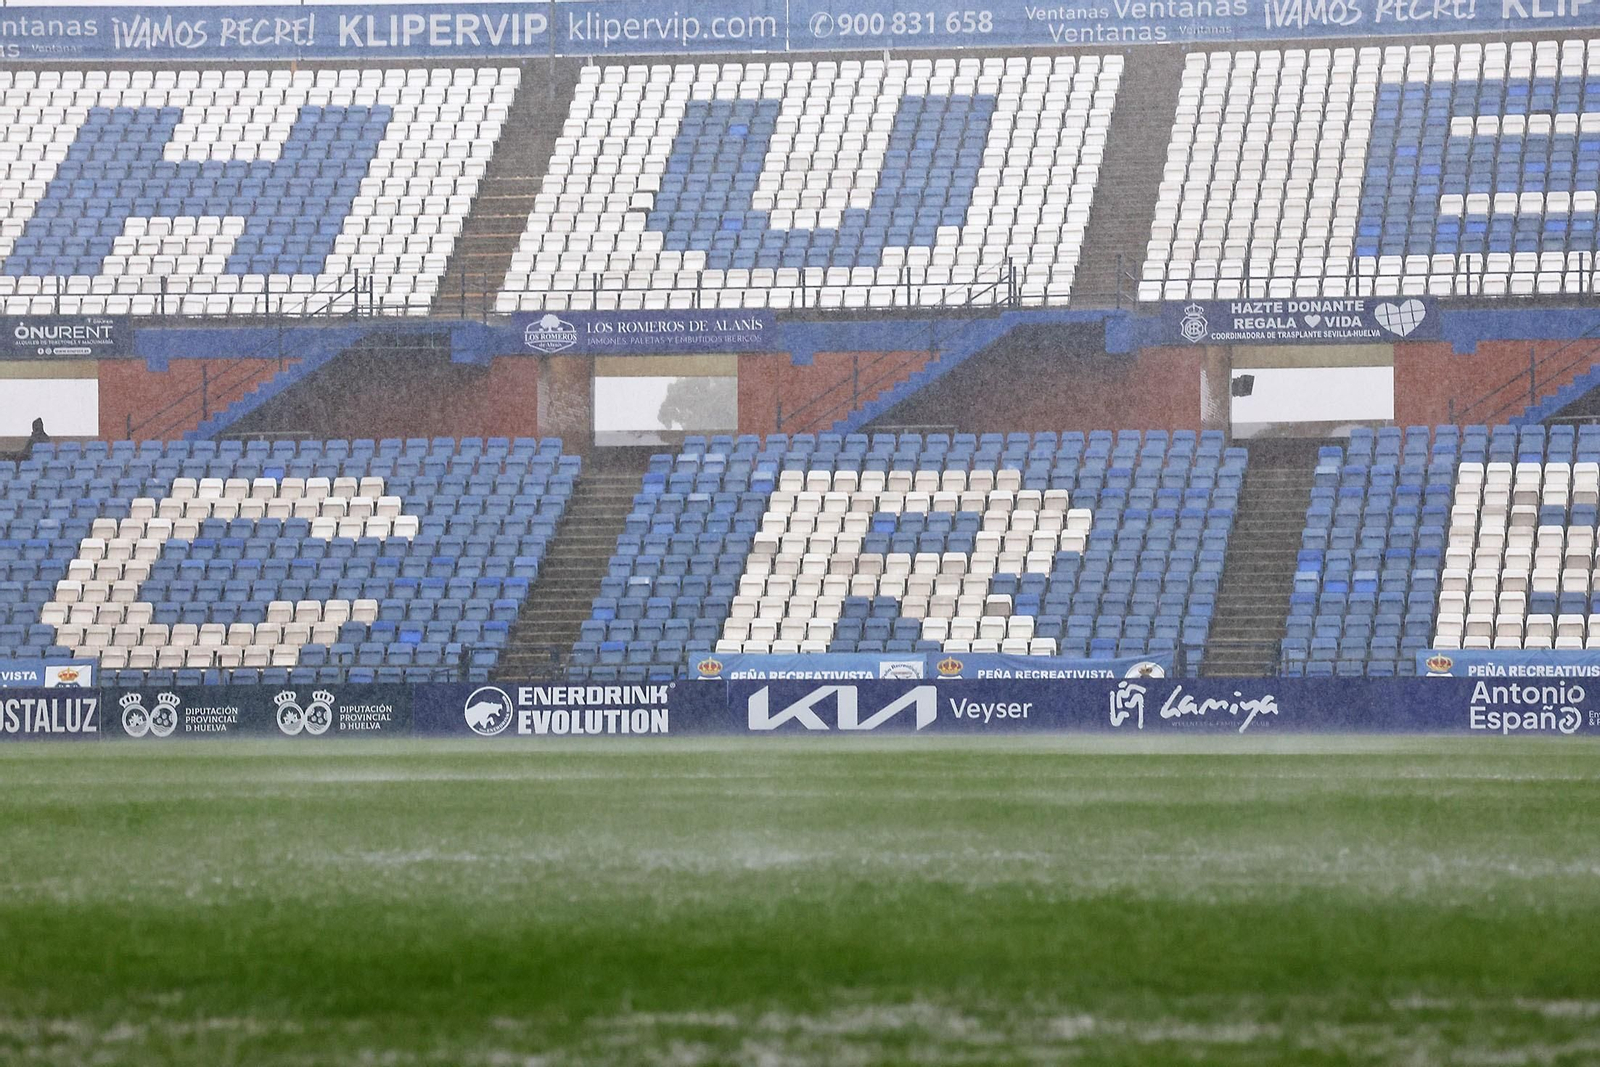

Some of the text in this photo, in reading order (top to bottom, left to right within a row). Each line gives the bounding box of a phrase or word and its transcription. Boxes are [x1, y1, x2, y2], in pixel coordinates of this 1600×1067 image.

[1025, 0, 1248, 20] Ventanas Ventanas
[219, 12, 315, 46] RECRE!
[339, 13, 548, 47] KLIPERVIP
[569, 11, 777, 47] klipervip.com
[837, 10, 993, 36] 900 831 658
[1048, 23, 1232, 43] Ventanas Ventanas
[1231, 300, 1365, 314] HAZTE DONANTE
[587, 316, 763, 334] LOS ROMEROS DE ALANÍS
[1234, 315, 1362, 330] REGALA VIDA
[630, 336, 665, 344] PALETAS
[674, 335, 722, 344] EMBUTIDOS
[1211, 329, 1381, 340] COORDINADORA DE TRASPLANTE SEVILLA-HUELVA
[730, 668, 767, 679] PEÑA
[769, 670, 874, 679] RECREATIVISTA
[978, 668, 1114, 679] PEÑA RECREATIVISTA
[1468, 662, 1506, 677] PEÑA
[1470, 680, 1586, 704] Antonio
[0, 698, 97, 732] STALUZ
[185, 705, 238, 715] DIPUTACIÓN
[339, 703, 392, 713] DIPUTACIÓN
[950, 697, 1032, 724] Veyser
[185, 715, 237, 723] PROVINCIAL
[339, 713, 391, 721] PROVINCIAL
[517, 709, 669, 735] EVOLUTION
[194, 723, 227, 731] HUELVA
[348, 722, 381, 730] HUELVA
